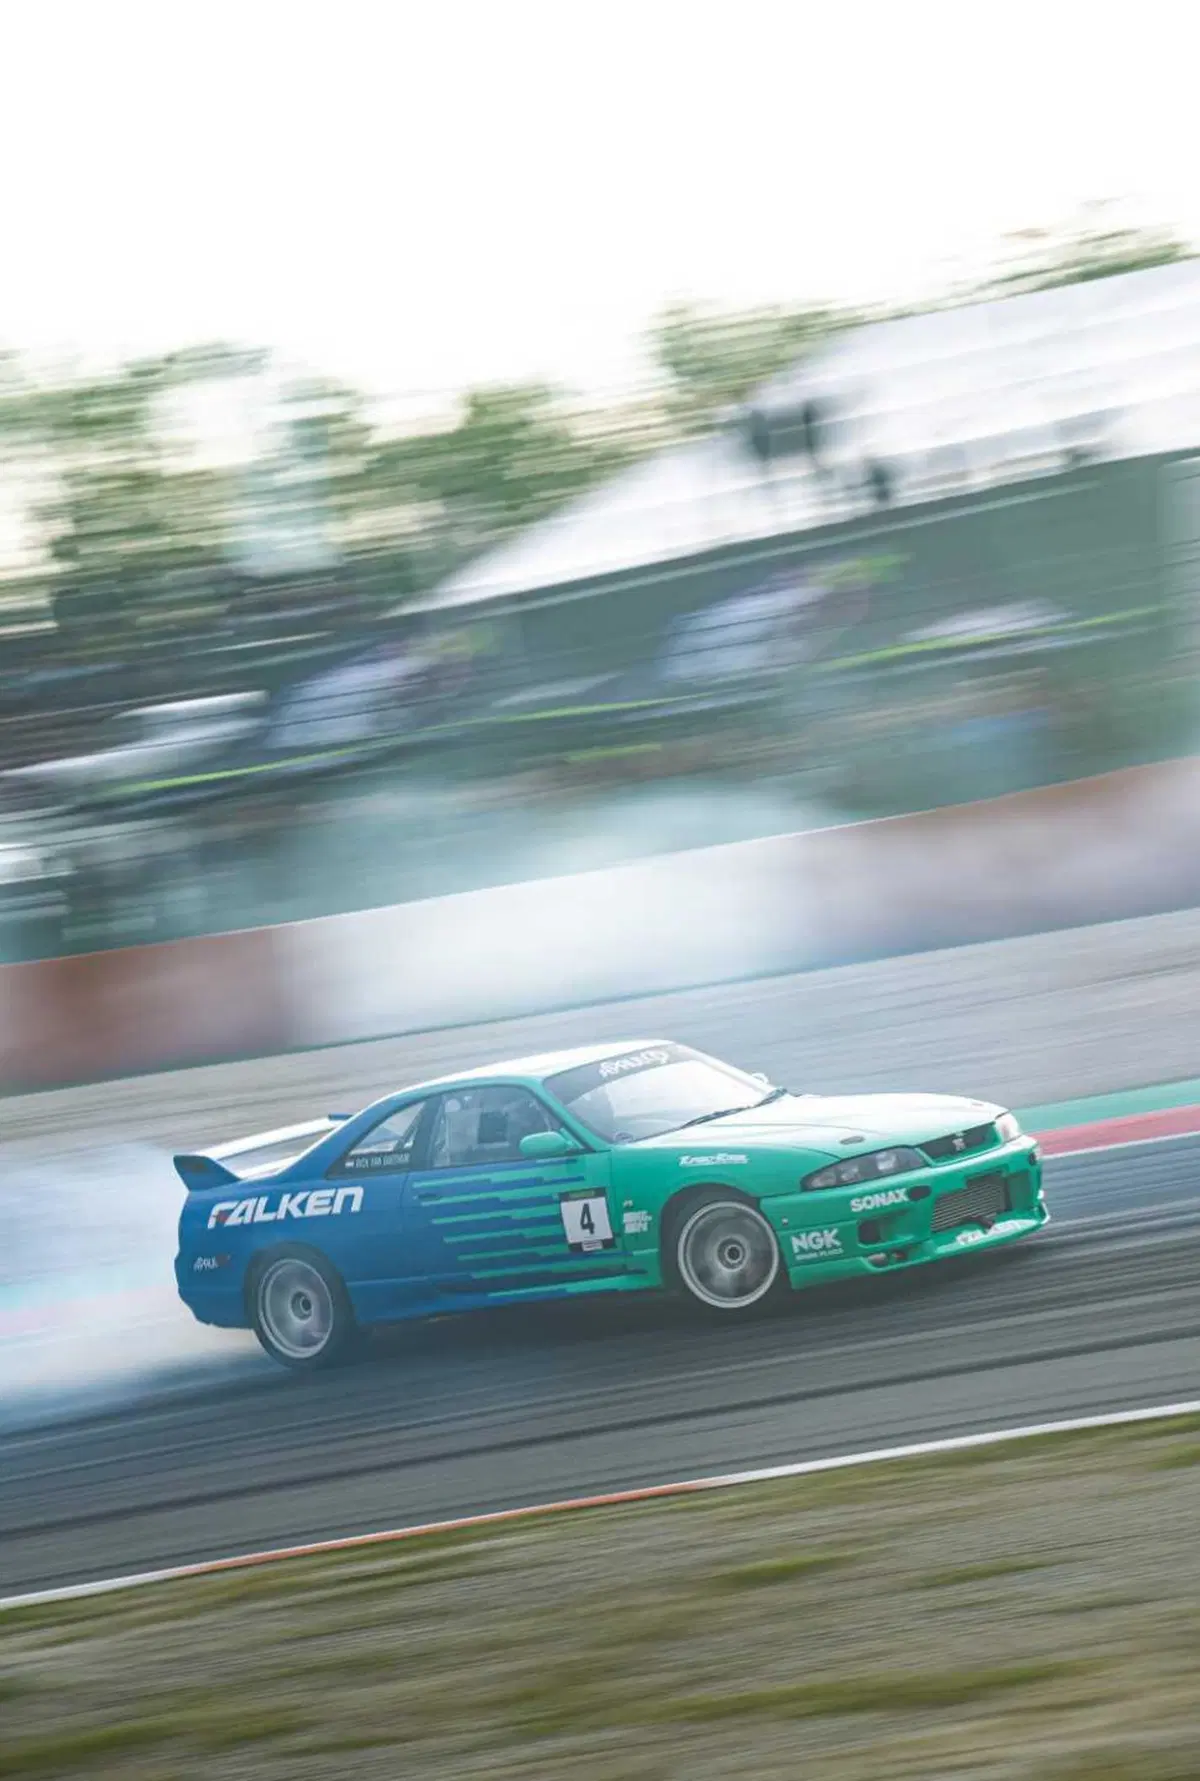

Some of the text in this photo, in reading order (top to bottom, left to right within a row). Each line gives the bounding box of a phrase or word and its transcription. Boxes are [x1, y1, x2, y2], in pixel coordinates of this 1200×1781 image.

[207, 1186, 364, 1230] FALKEN
[850, 1187, 909, 1212] SONAX
[580, 1203, 595, 1235] 4
[791, 1228, 842, 1254] NGK
